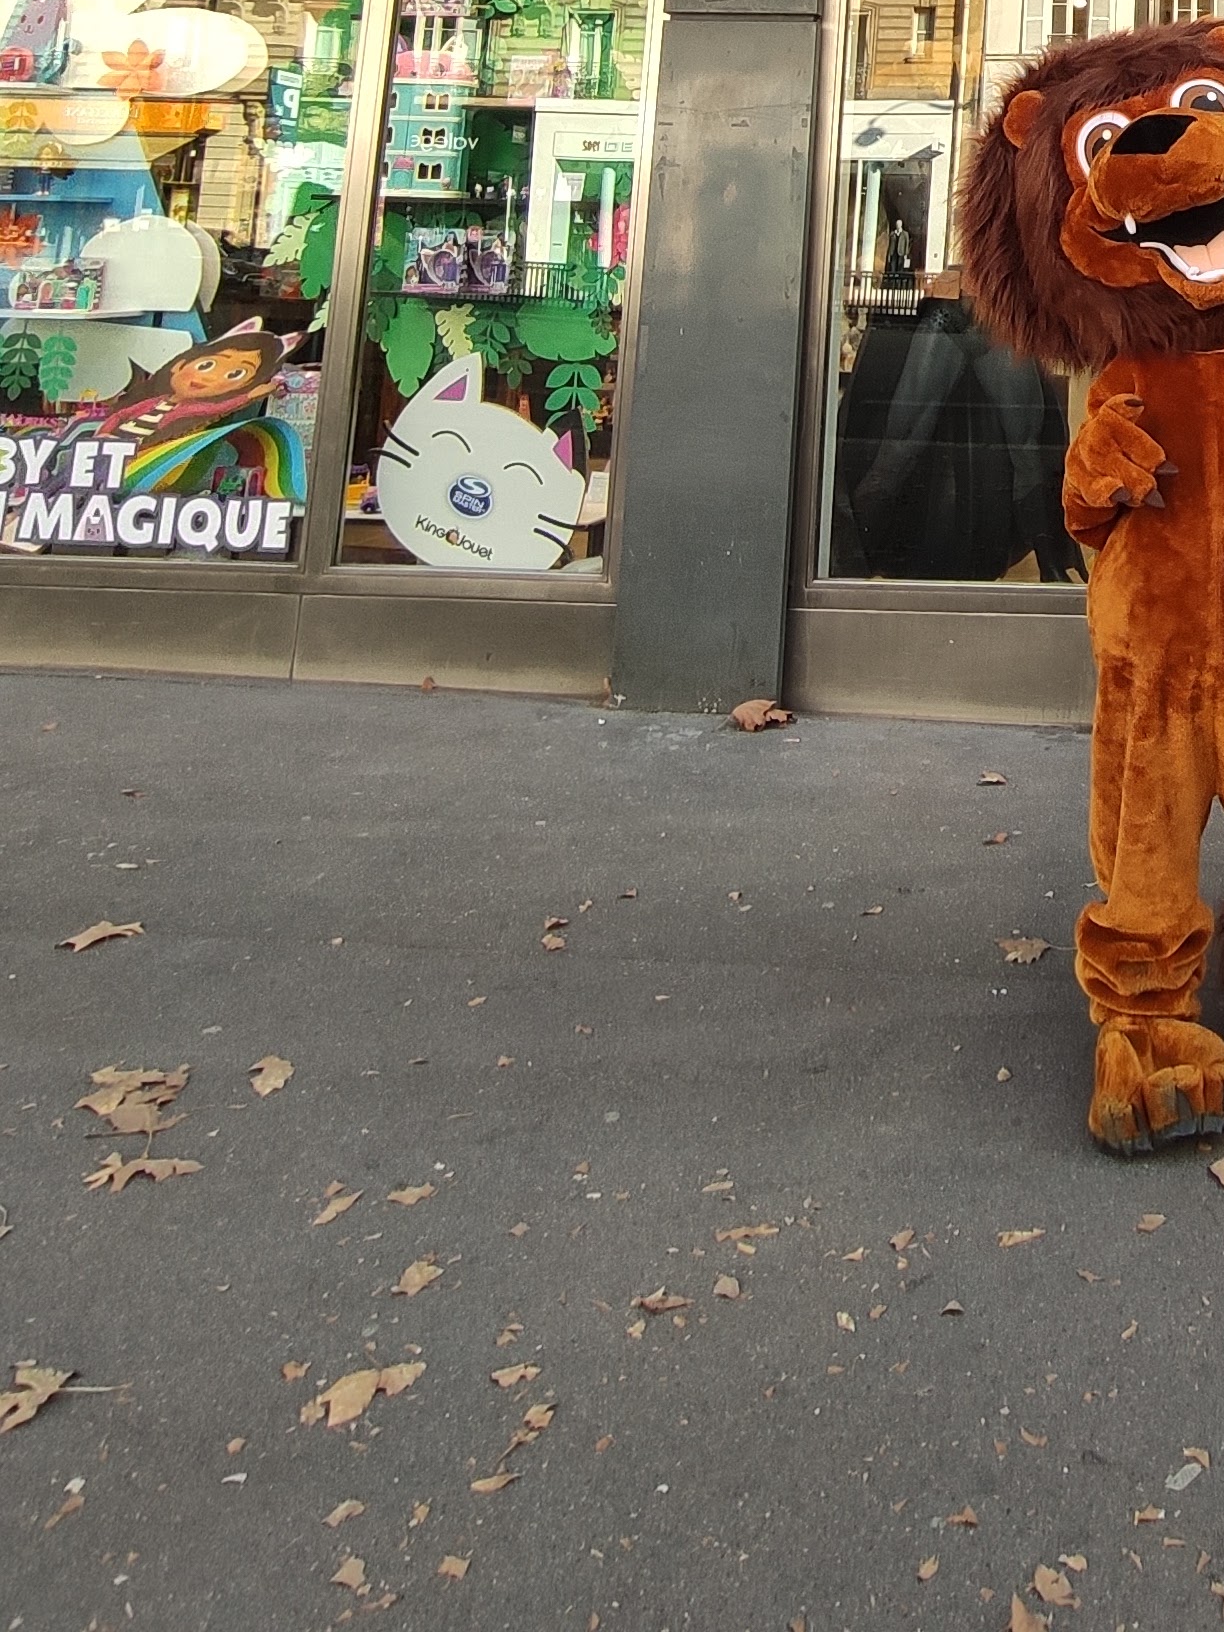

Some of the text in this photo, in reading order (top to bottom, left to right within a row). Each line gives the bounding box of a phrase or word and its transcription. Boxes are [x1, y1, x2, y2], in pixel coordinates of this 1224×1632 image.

[69, 441, 137, 488] ET
[453, 490, 485, 509] SPIN
[18, 492, 291, 552] MAGIQUE
[456, 534, 493, 561] Jouet
